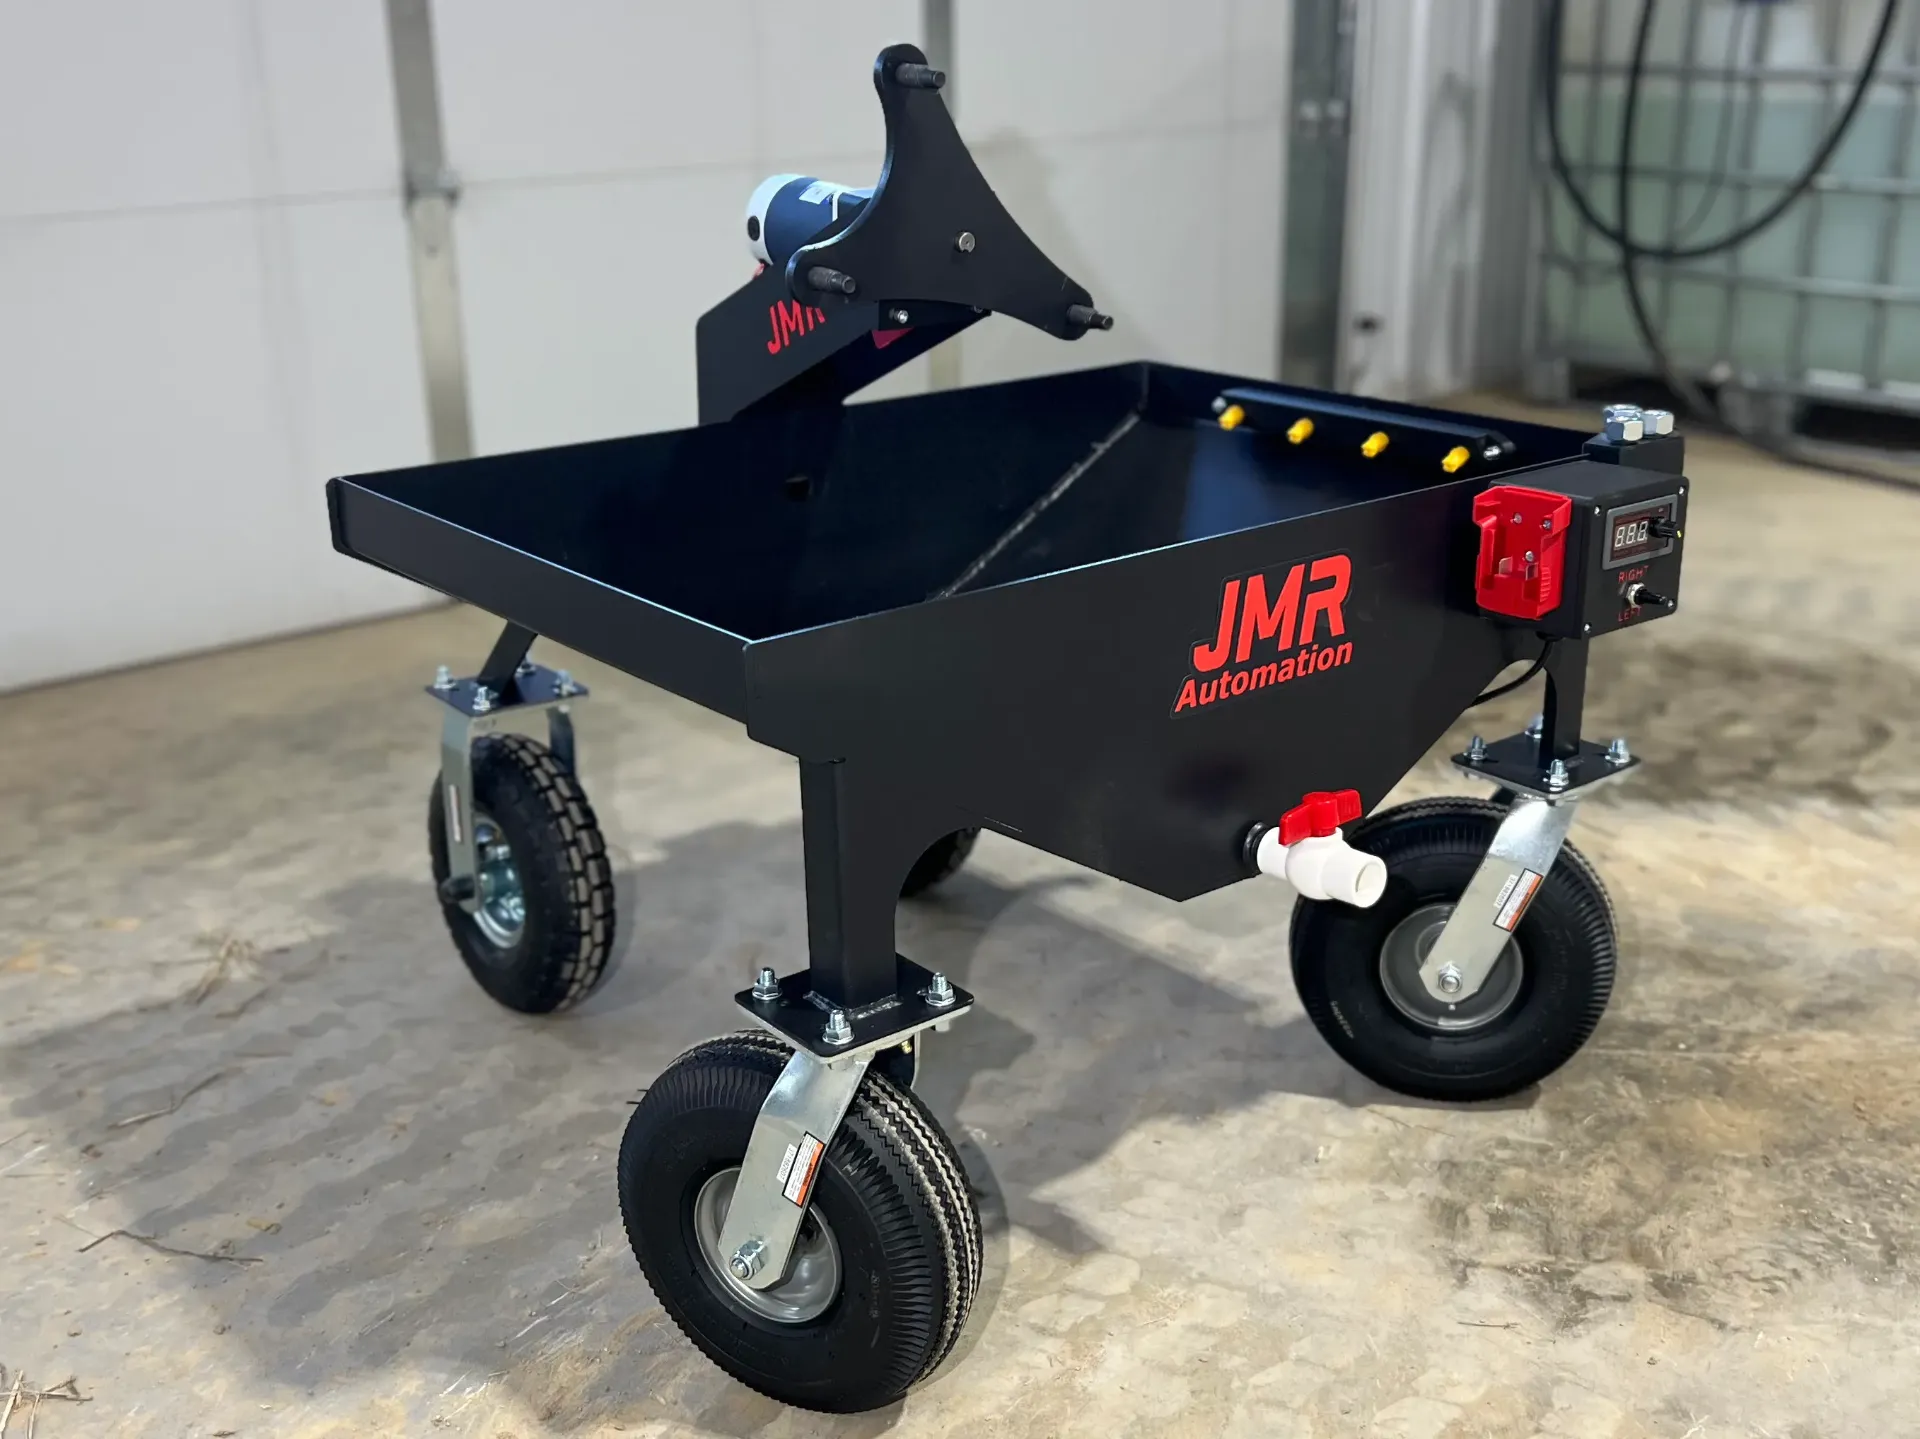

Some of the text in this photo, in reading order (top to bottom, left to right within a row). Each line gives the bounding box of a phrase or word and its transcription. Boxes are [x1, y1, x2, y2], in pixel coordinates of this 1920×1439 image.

[1618, 565, 1649, 583] RIGHT
[1193, 554, 1351, 672] JMR
[1174, 641, 1353, 713] Automation
